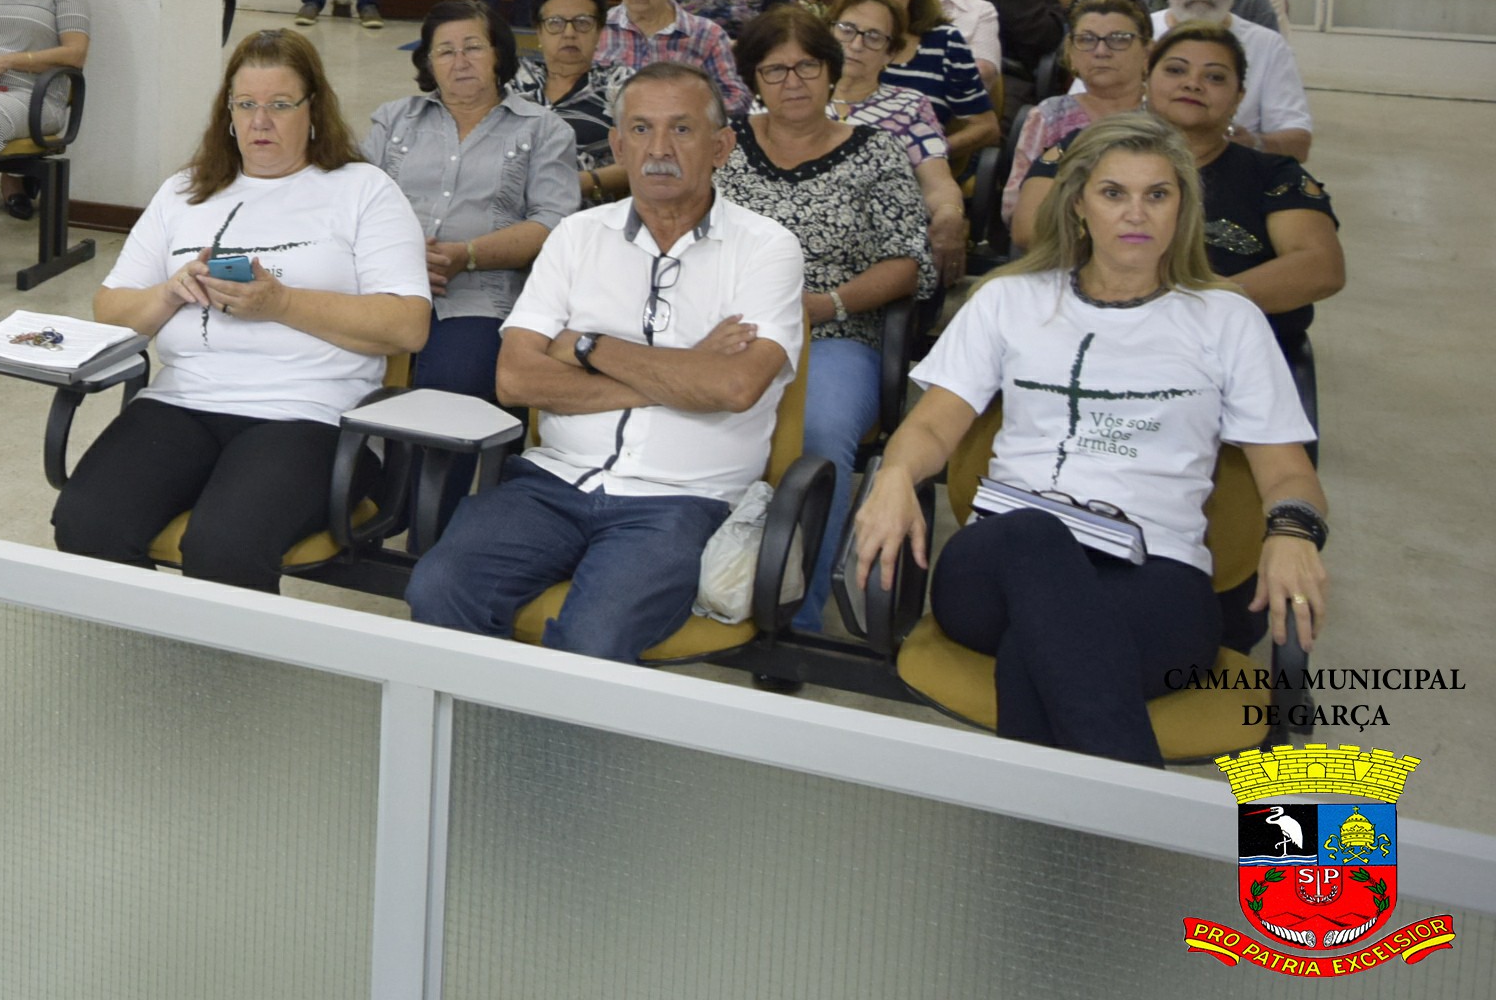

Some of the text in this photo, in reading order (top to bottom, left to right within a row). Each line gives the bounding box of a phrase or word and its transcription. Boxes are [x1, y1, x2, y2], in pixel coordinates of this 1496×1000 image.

[1089, 411, 1162, 432] Vós sois
[1076, 436, 1138, 458] irmãos
